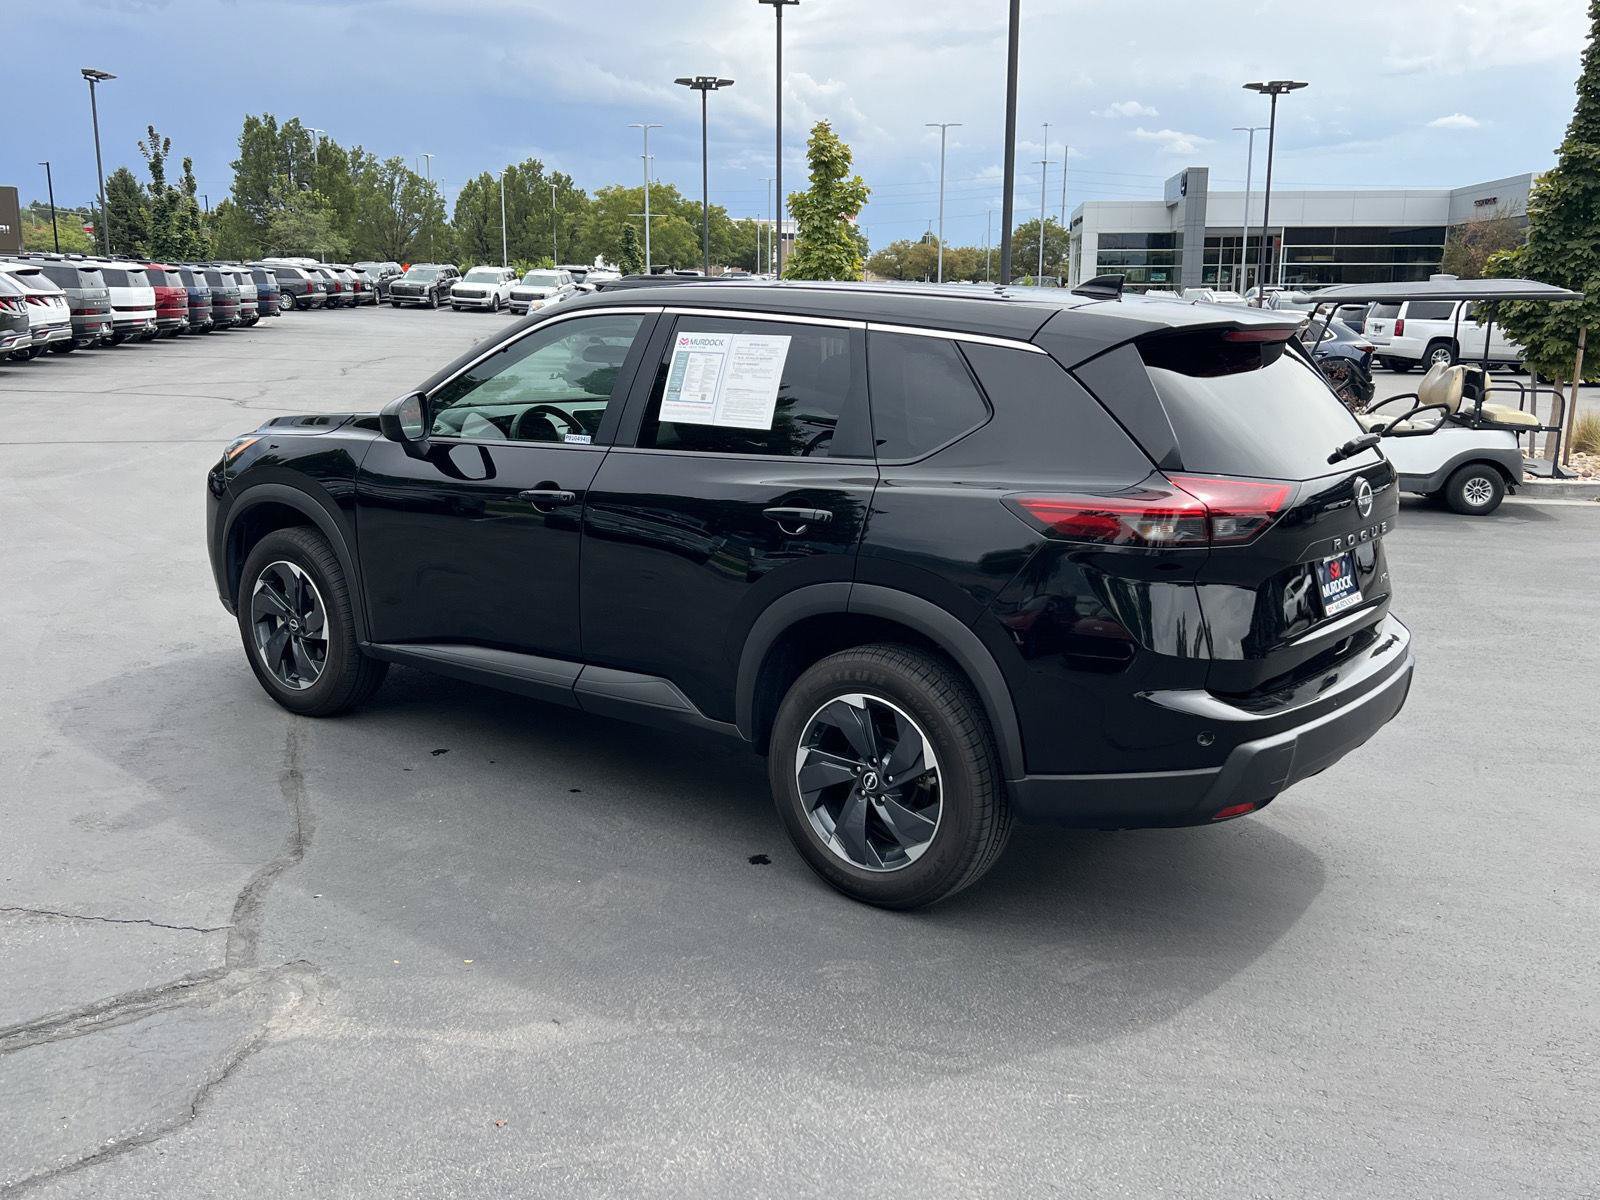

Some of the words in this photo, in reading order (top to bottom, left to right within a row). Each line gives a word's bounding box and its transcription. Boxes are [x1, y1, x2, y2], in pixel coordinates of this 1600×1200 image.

[689, 338, 724, 346] MURDOCK
[1332, 521, 1387, 551] ROGUE
[1321, 574, 1353, 598] MURDOCK
